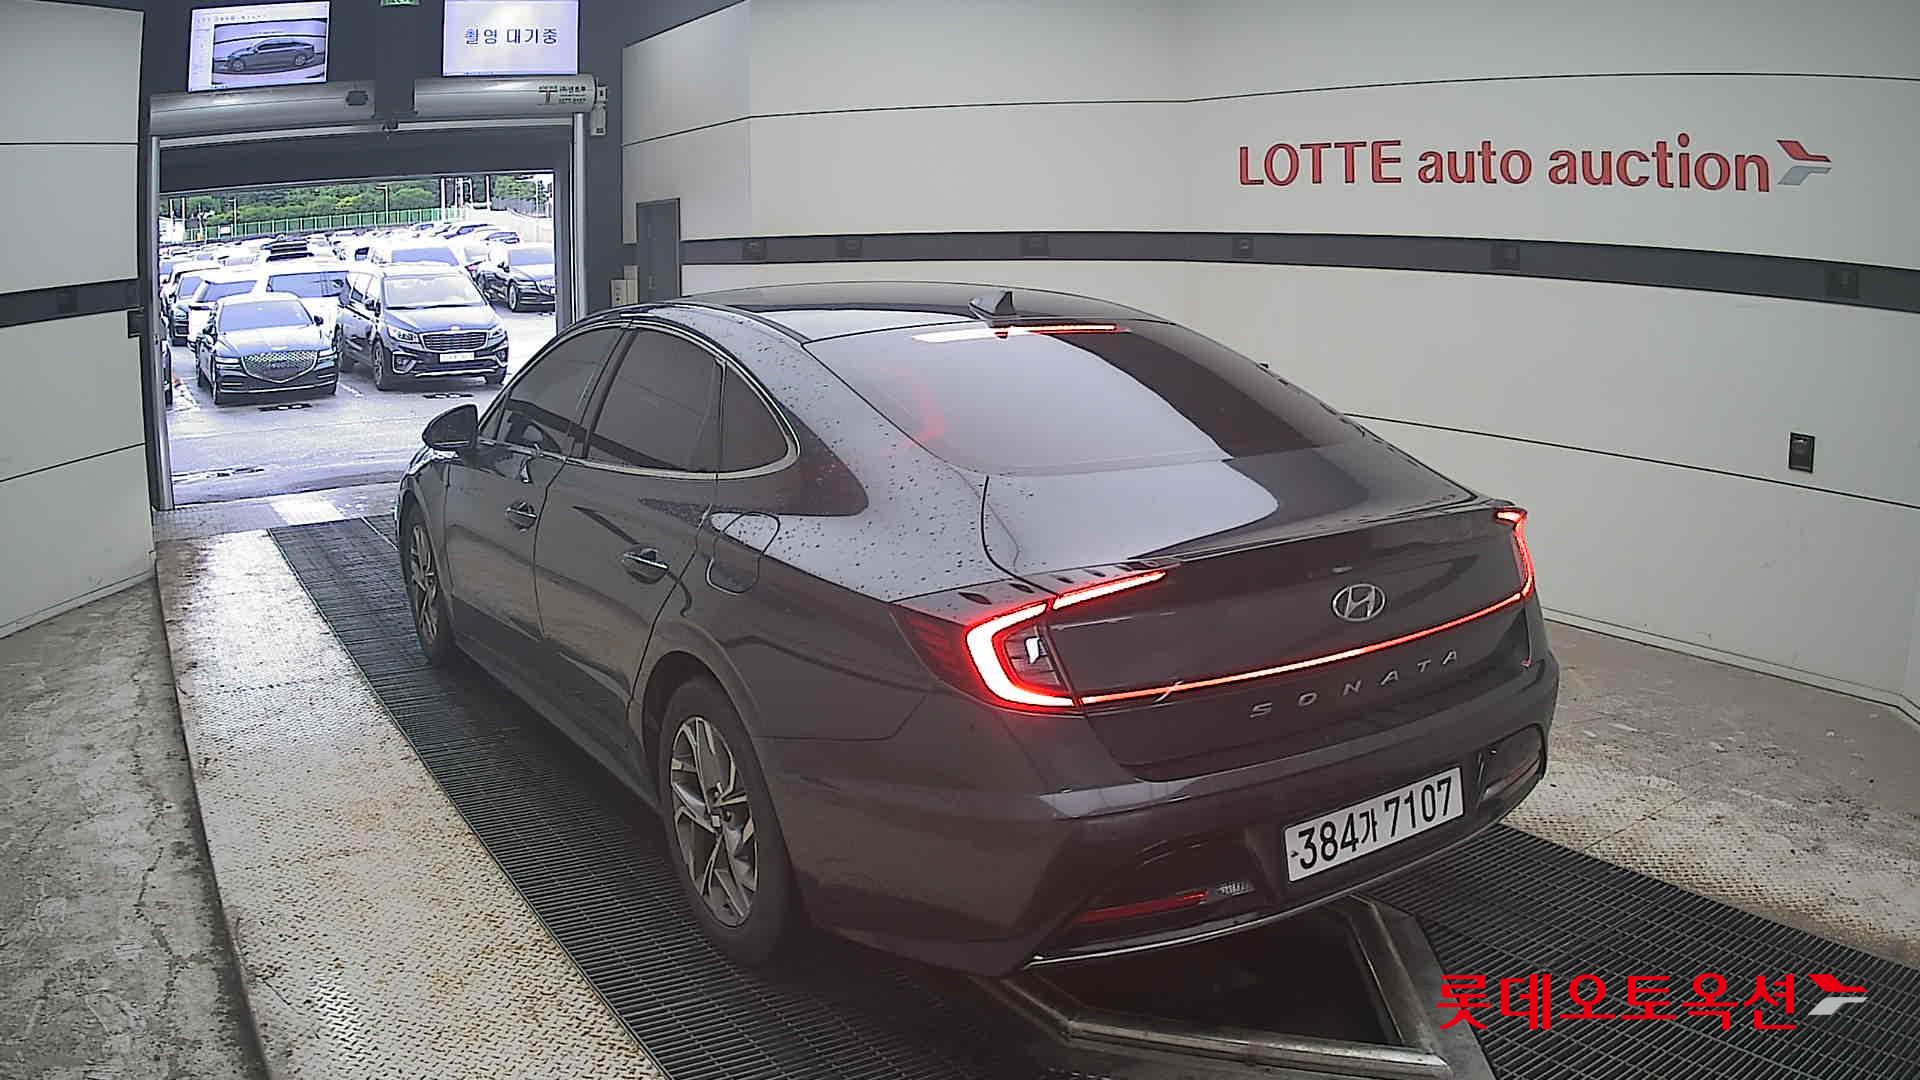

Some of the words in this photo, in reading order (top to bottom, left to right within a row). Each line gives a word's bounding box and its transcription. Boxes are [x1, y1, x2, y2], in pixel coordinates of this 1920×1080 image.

[506, 28, 558, 45] 대기중
[1239, 140, 1401, 186] LOTTE
[1417, 140, 1533, 185] auto
[1548, 133, 1771, 192] auction
[1249, 649, 1459, 719] SONATA
[1298, 807, 1378, 870] 384가
[1384, 776, 1452, 838] 7107
